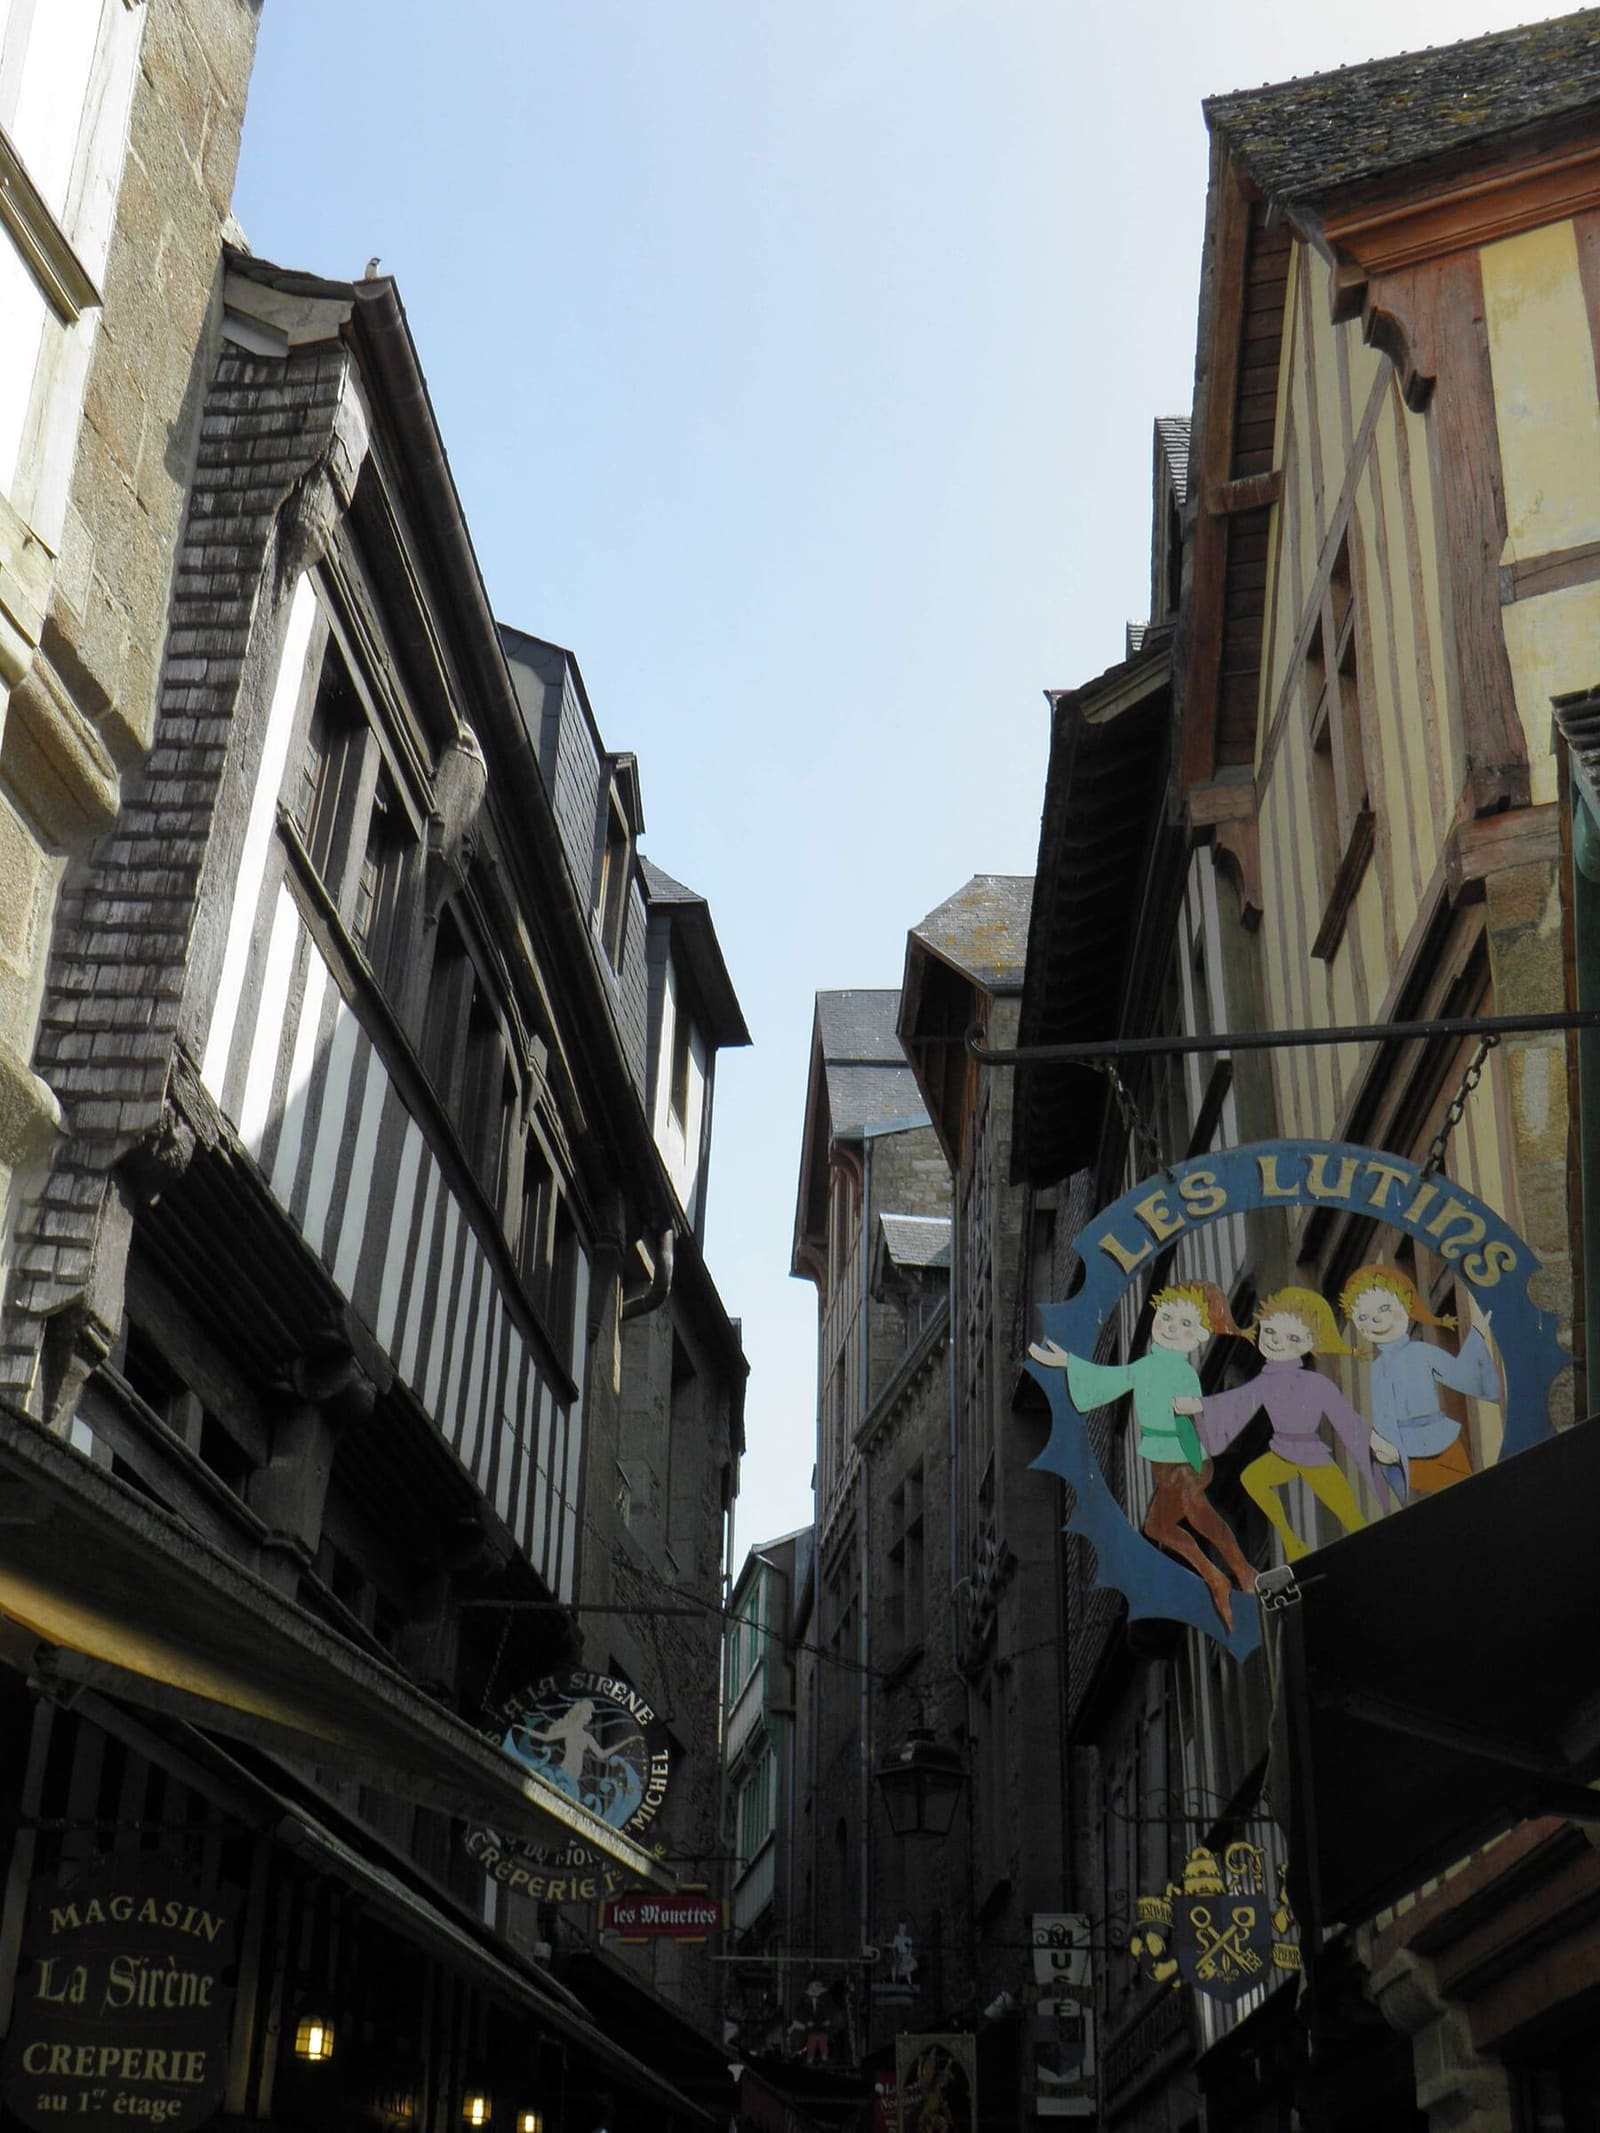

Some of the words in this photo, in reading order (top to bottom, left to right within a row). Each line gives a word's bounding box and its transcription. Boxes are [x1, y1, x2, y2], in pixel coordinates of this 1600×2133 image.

[1098, 1171, 1228, 1275] LES
[1257, 1153, 1518, 1288] LUTINS
[630, 1748, 670, 1832] MICHEL
[50, 1895, 225, 1943] MAGASIN
[613, 1904, 636, 1925] les
[34, 1956, 88, 2004] La
[100, 1954, 215, 2016] Sirène
[22, 2042, 207, 2083] CREPERIE
[36, 2093, 67, 2111] au
[112, 2091, 182, 2123] étage
